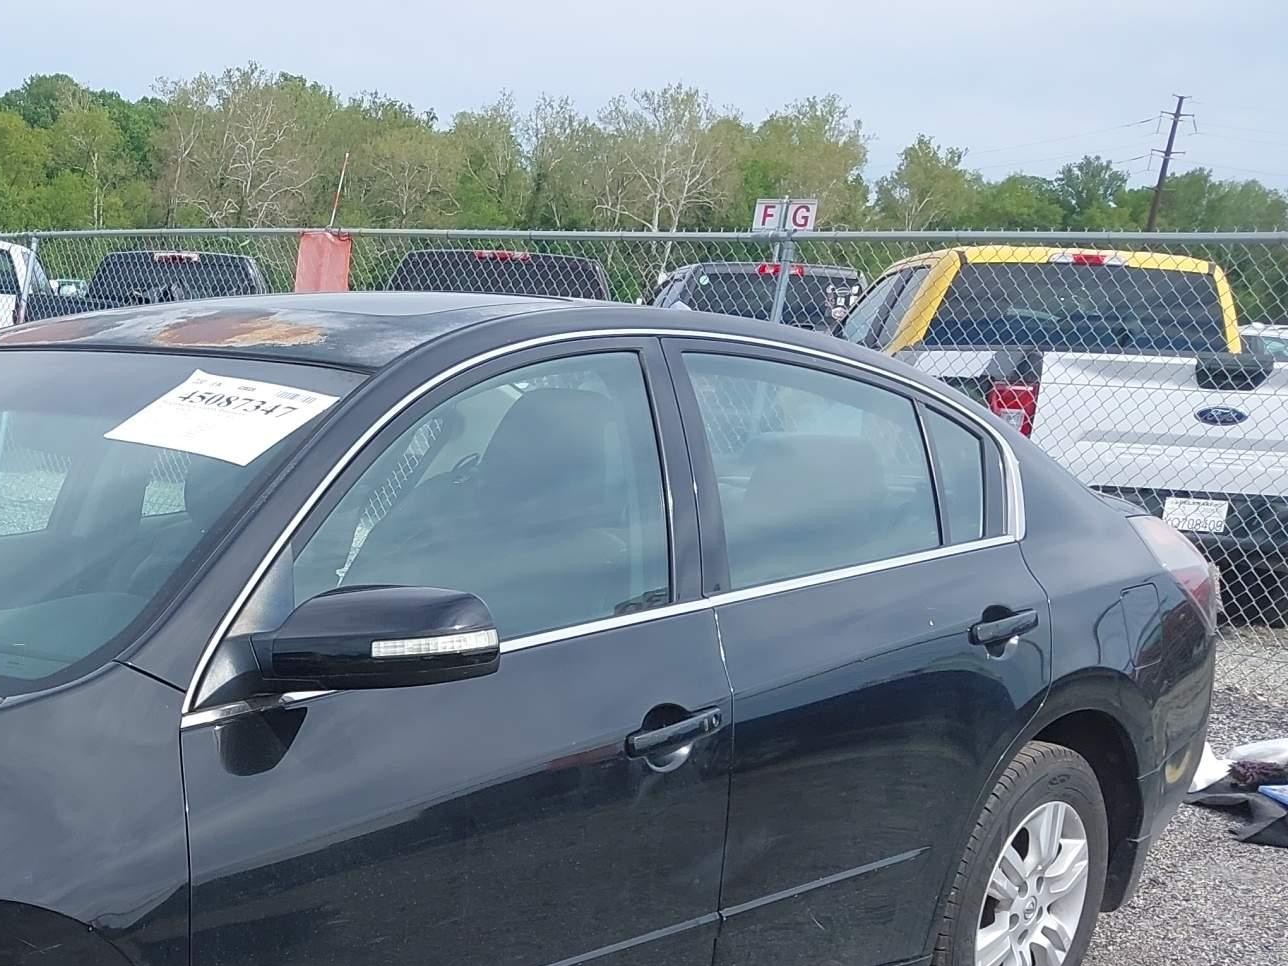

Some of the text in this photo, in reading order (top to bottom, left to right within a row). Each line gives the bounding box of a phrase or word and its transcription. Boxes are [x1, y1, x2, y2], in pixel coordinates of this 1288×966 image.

[761, 205, 776, 227] F
[792, 204, 810, 228] G
[177, 390, 300, 418] 45087347
